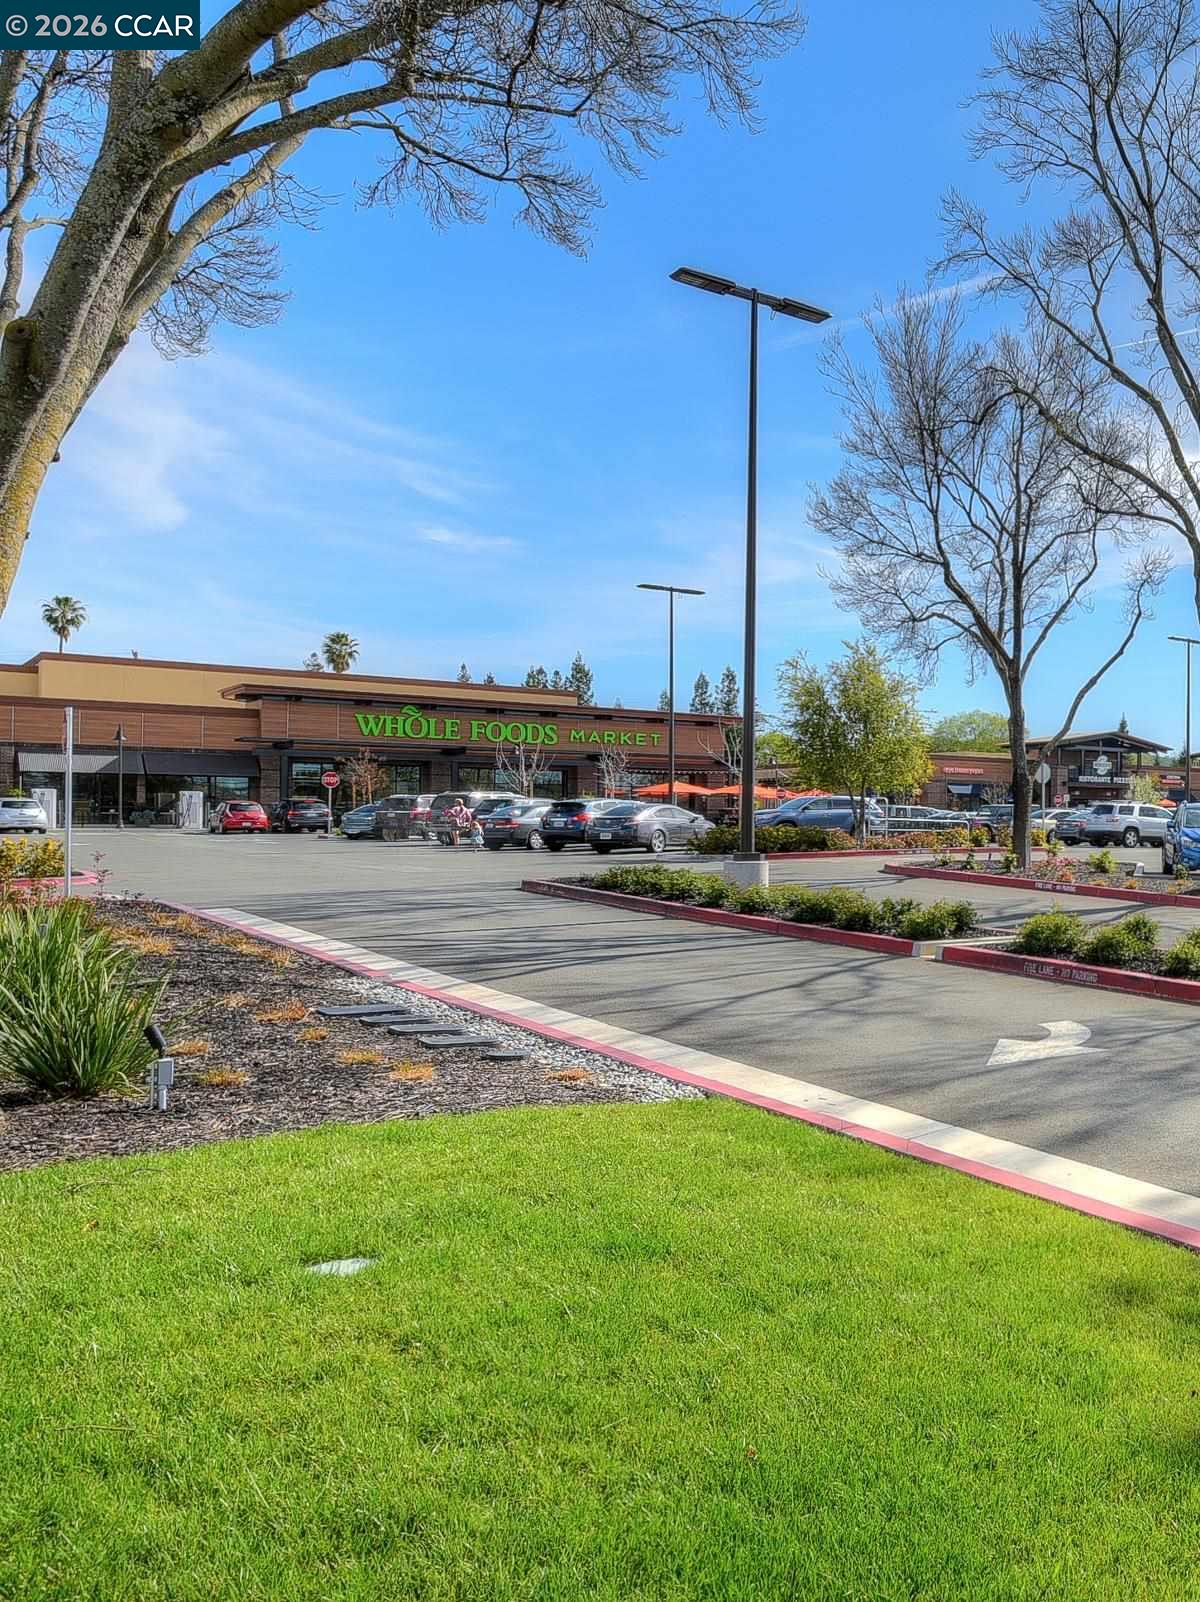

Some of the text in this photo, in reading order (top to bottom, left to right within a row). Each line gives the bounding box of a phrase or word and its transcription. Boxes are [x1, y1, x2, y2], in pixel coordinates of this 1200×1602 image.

[354, 705, 662, 747] WHOLE FOODS MARKET
